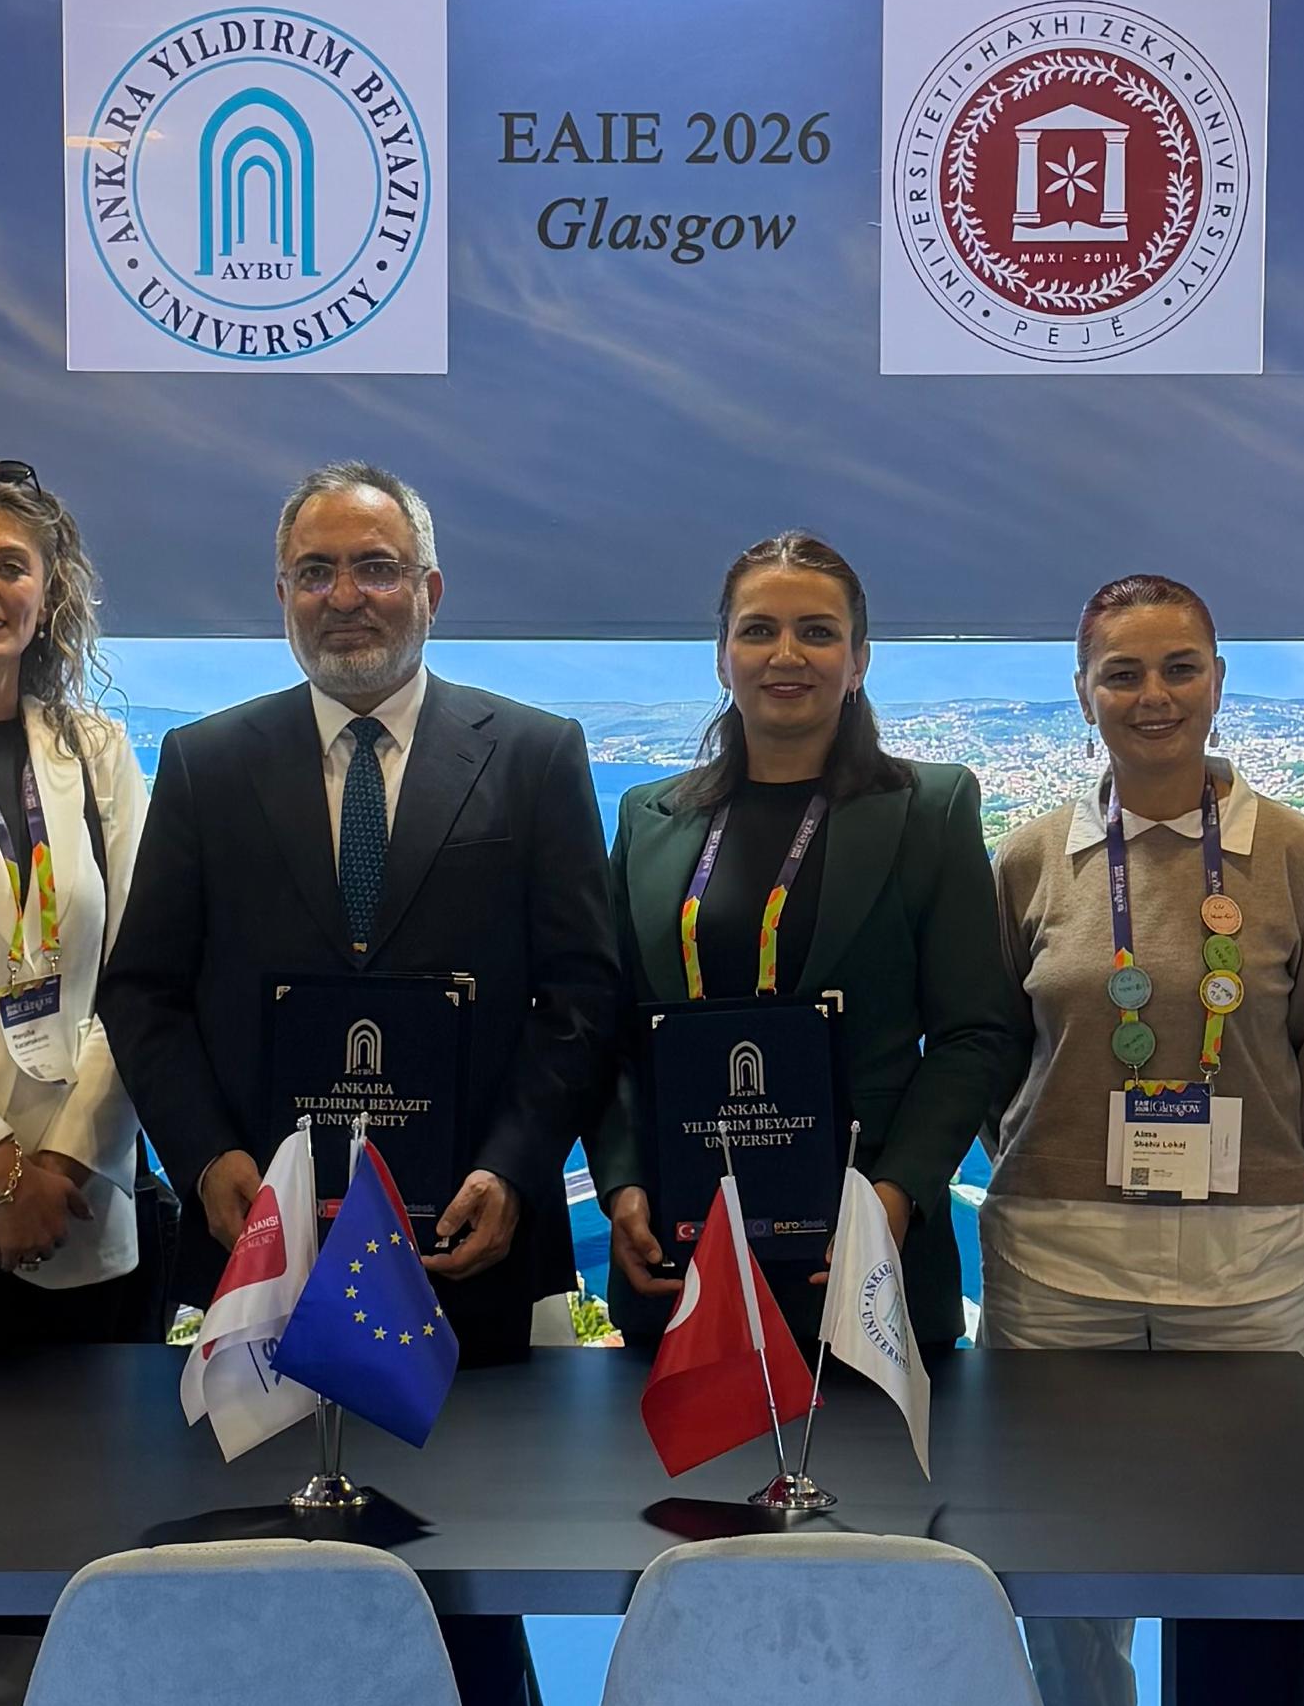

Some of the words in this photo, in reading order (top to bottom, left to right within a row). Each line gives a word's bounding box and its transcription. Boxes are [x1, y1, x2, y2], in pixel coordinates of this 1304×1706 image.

[979, 15, 1085, 63] HAXHI
[1099, 19, 1176, 72] ZEKA
[96, 84, 155, 244] ANKARA
[147, 19, 355, 81] YILDIRIM
[351, 71, 419, 253] BEYAZIT
[498, 112, 664, 166] EAIE
[685, 111, 831, 166] 2026
[908, 74, 976, 309] UNIVERSITETI
[1181, 87, 1235, 298] UNIVERSITY
[536, 196, 797, 264] Glasgow
[220, 262, 294, 281] AYBU
[1019, 252, 1065, 264] MMXI
[1083, 252, 1122, 264] 2011
[137, 276, 380, 356] UNIVERSITY
[1013, 315, 1126, 346] PEJË
[294, 1096, 365, 1111] YILDIRIM
[369, 1098, 432, 1112] BEYAZIT
[331, 1082, 395, 1095] ANKARA
[316, 1113, 409, 1127] UNIVSITY
[682, 1120, 752, 1134] YILDRIM
[755, 1116, 816, 1131] BEYAZIT
[717, 1103, 779, 1117] ANKARA
[864, 1262, 894, 1301] ANKAR
[862, 1311, 908, 1370] UNIVERSIT
